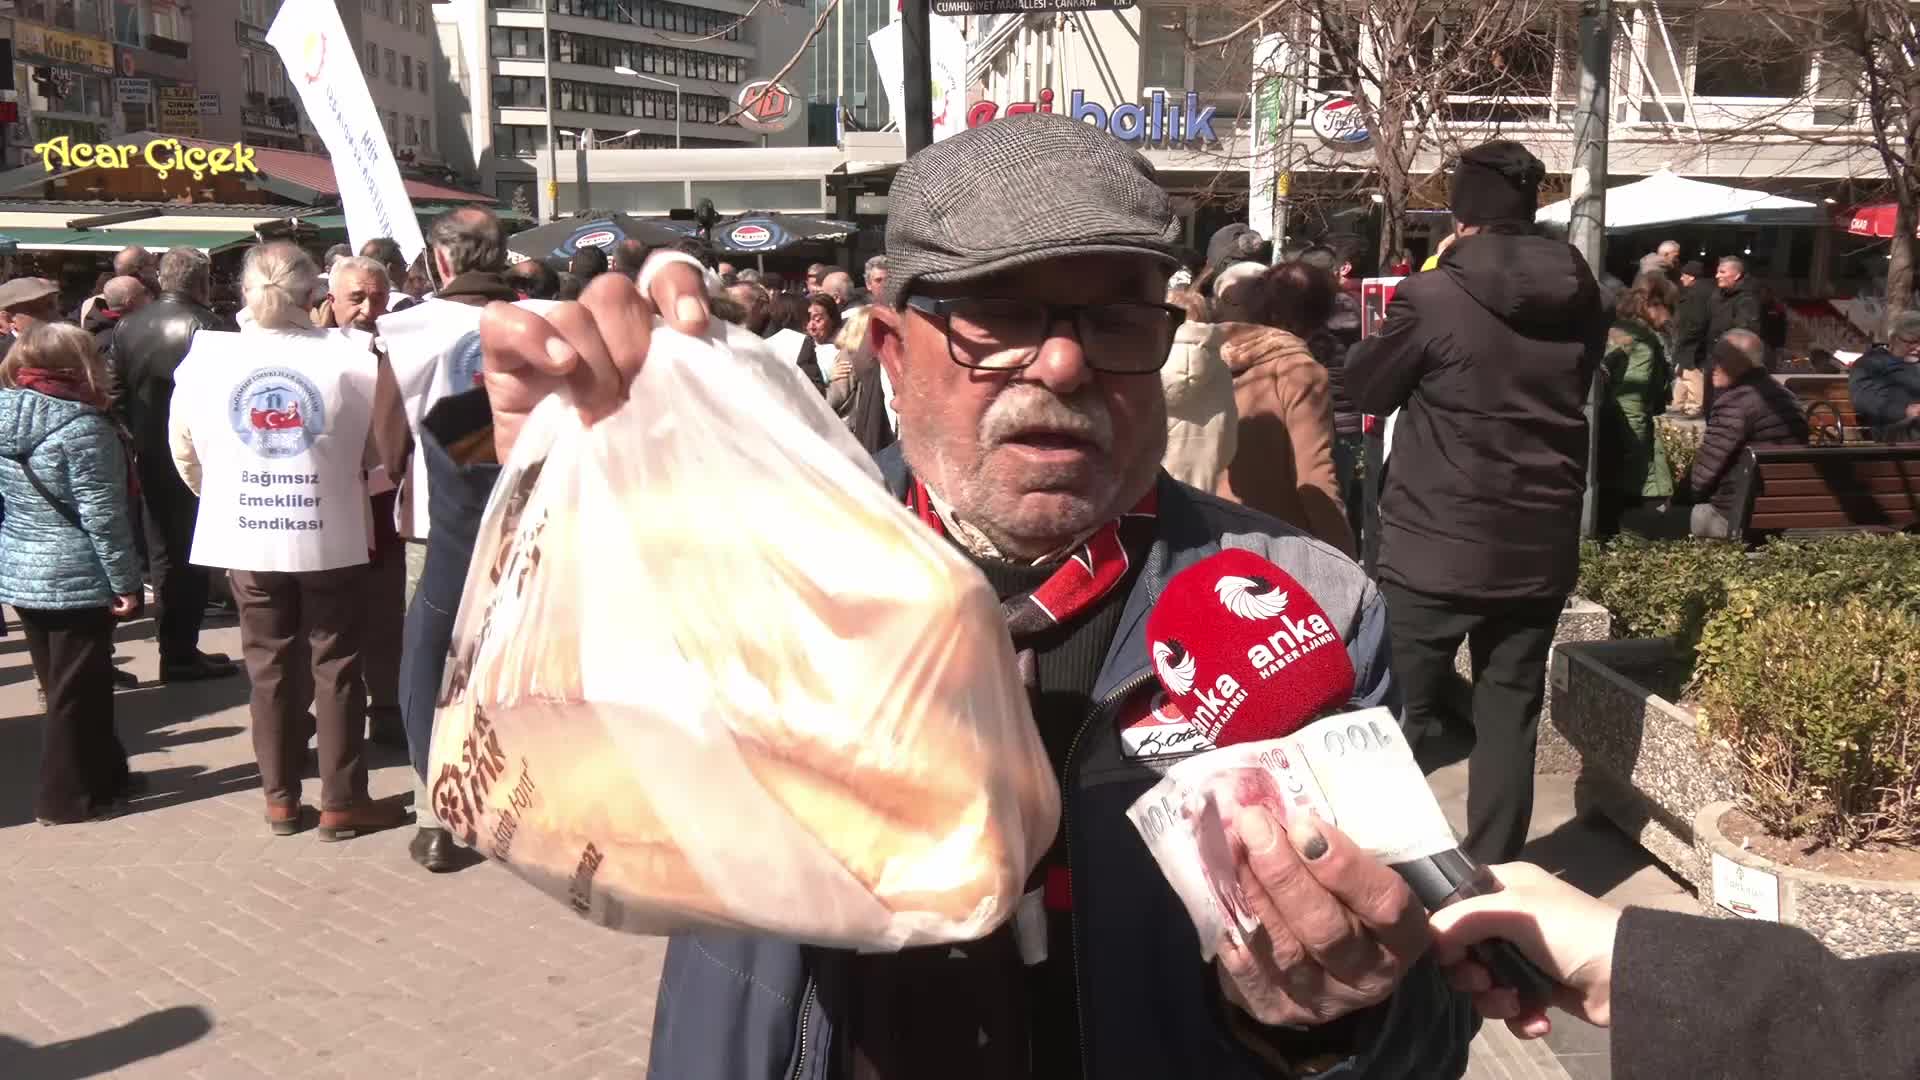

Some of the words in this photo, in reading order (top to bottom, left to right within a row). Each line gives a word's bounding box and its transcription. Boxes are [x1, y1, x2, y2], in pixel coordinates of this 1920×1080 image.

[1070, 89, 1217, 143] balık
[34, 136, 138, 172] Acar
[144, 138, 259, 180] Çiçek
[241, 470, 320, 487] Bağımsız
[239, 493, 322, 508] Emekliler
[238, 516, 324, 531] Sendikası
[1247, 614, 1331, 669] anka
[1258, 648, 1302, 680] HABER
[1300, 632, 1336, 655] AJANSI
[1218, 688, 1249, 725] AJANSI
